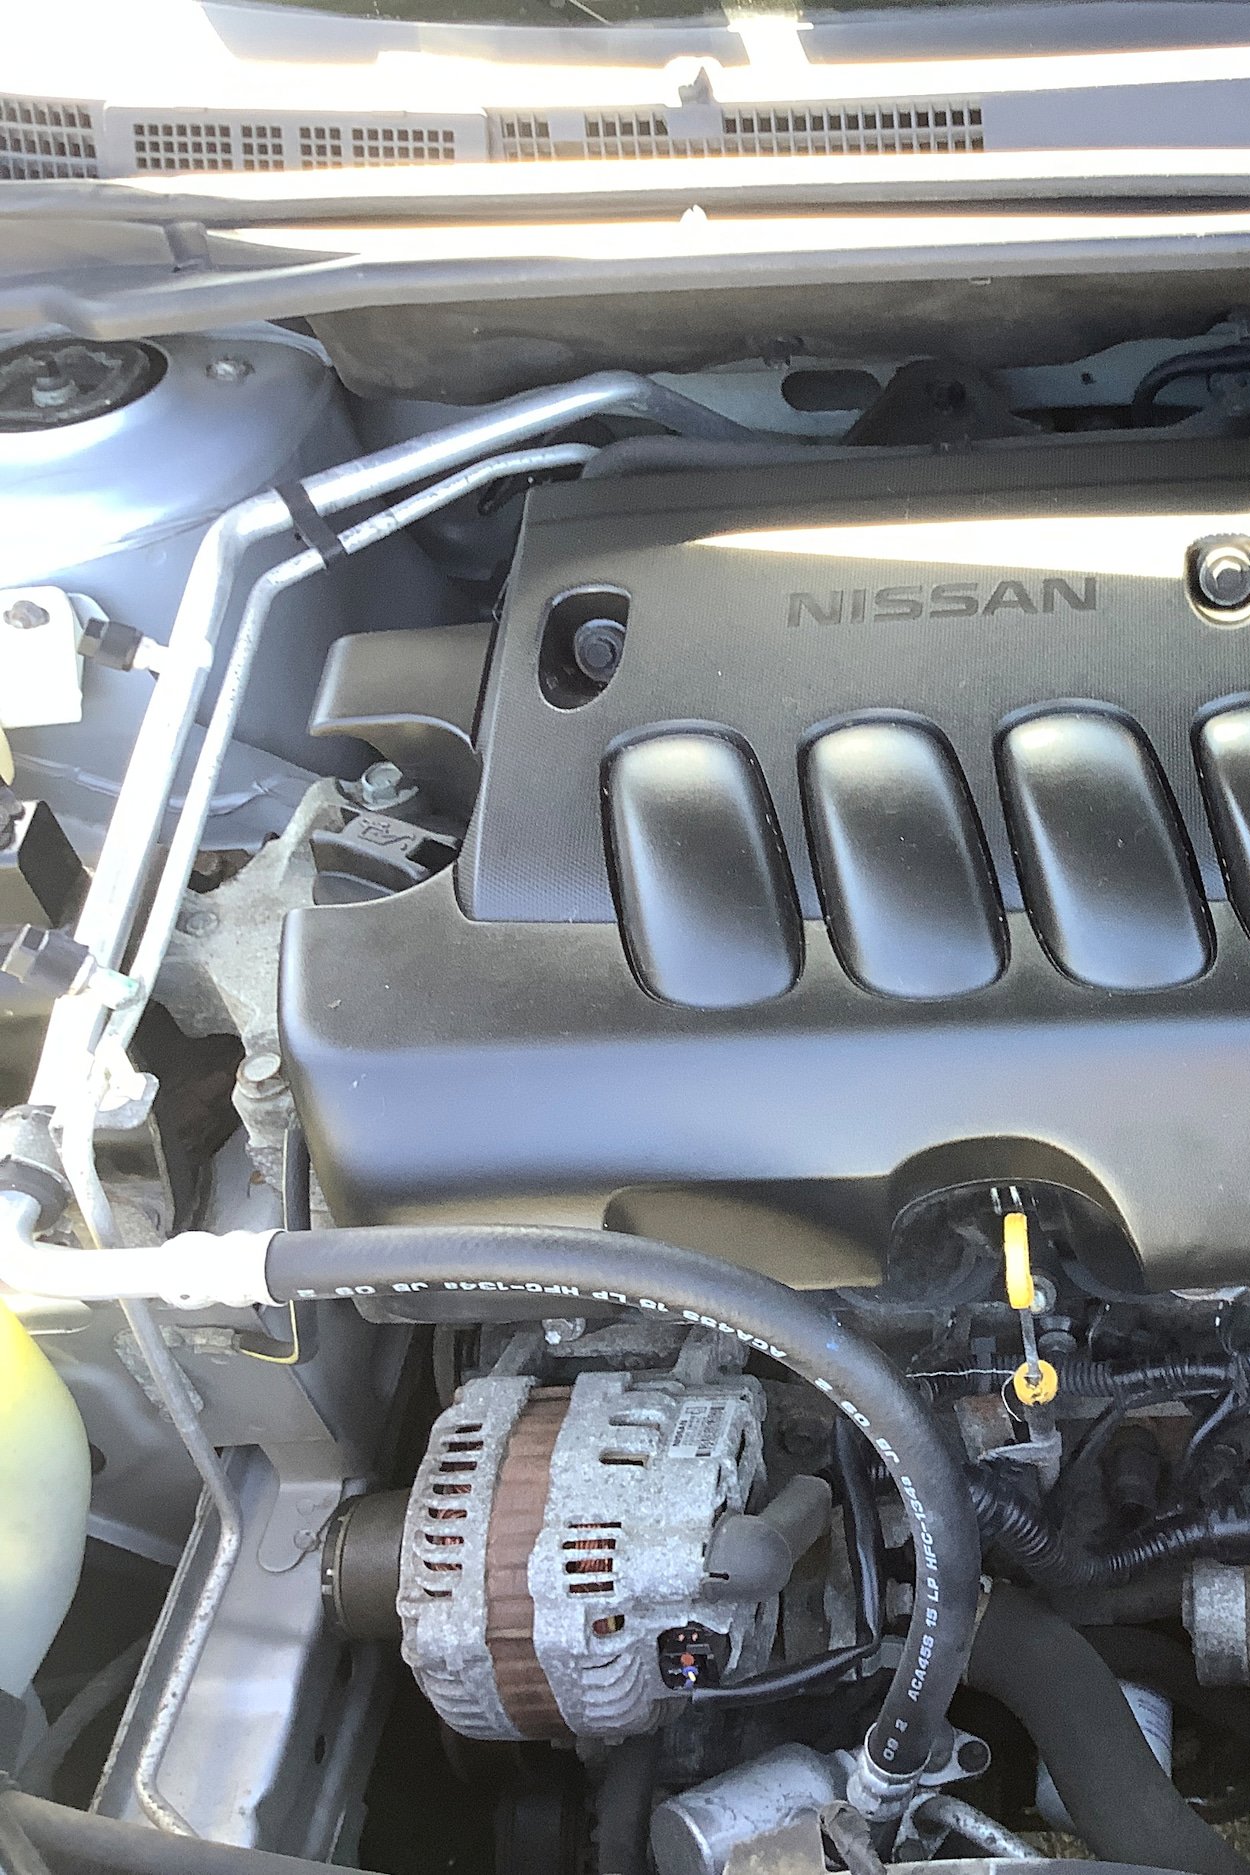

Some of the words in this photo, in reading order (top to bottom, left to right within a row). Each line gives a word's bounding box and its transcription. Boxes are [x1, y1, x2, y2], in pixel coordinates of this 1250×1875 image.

[787, 577, 1097, 627] NISSAN
[444, 1281, 580, 1296] HFC-134a
[592, 1290, 627, 1303] LP
[639, 1299, 669, 1312] 15
[901, 1476, 938, 1571] HFC-134a
[926, 1577, 939, 1602] LP
[925, 1607, 938, 1628] 15
[907, 1634, 934, 1702] ACA45S
